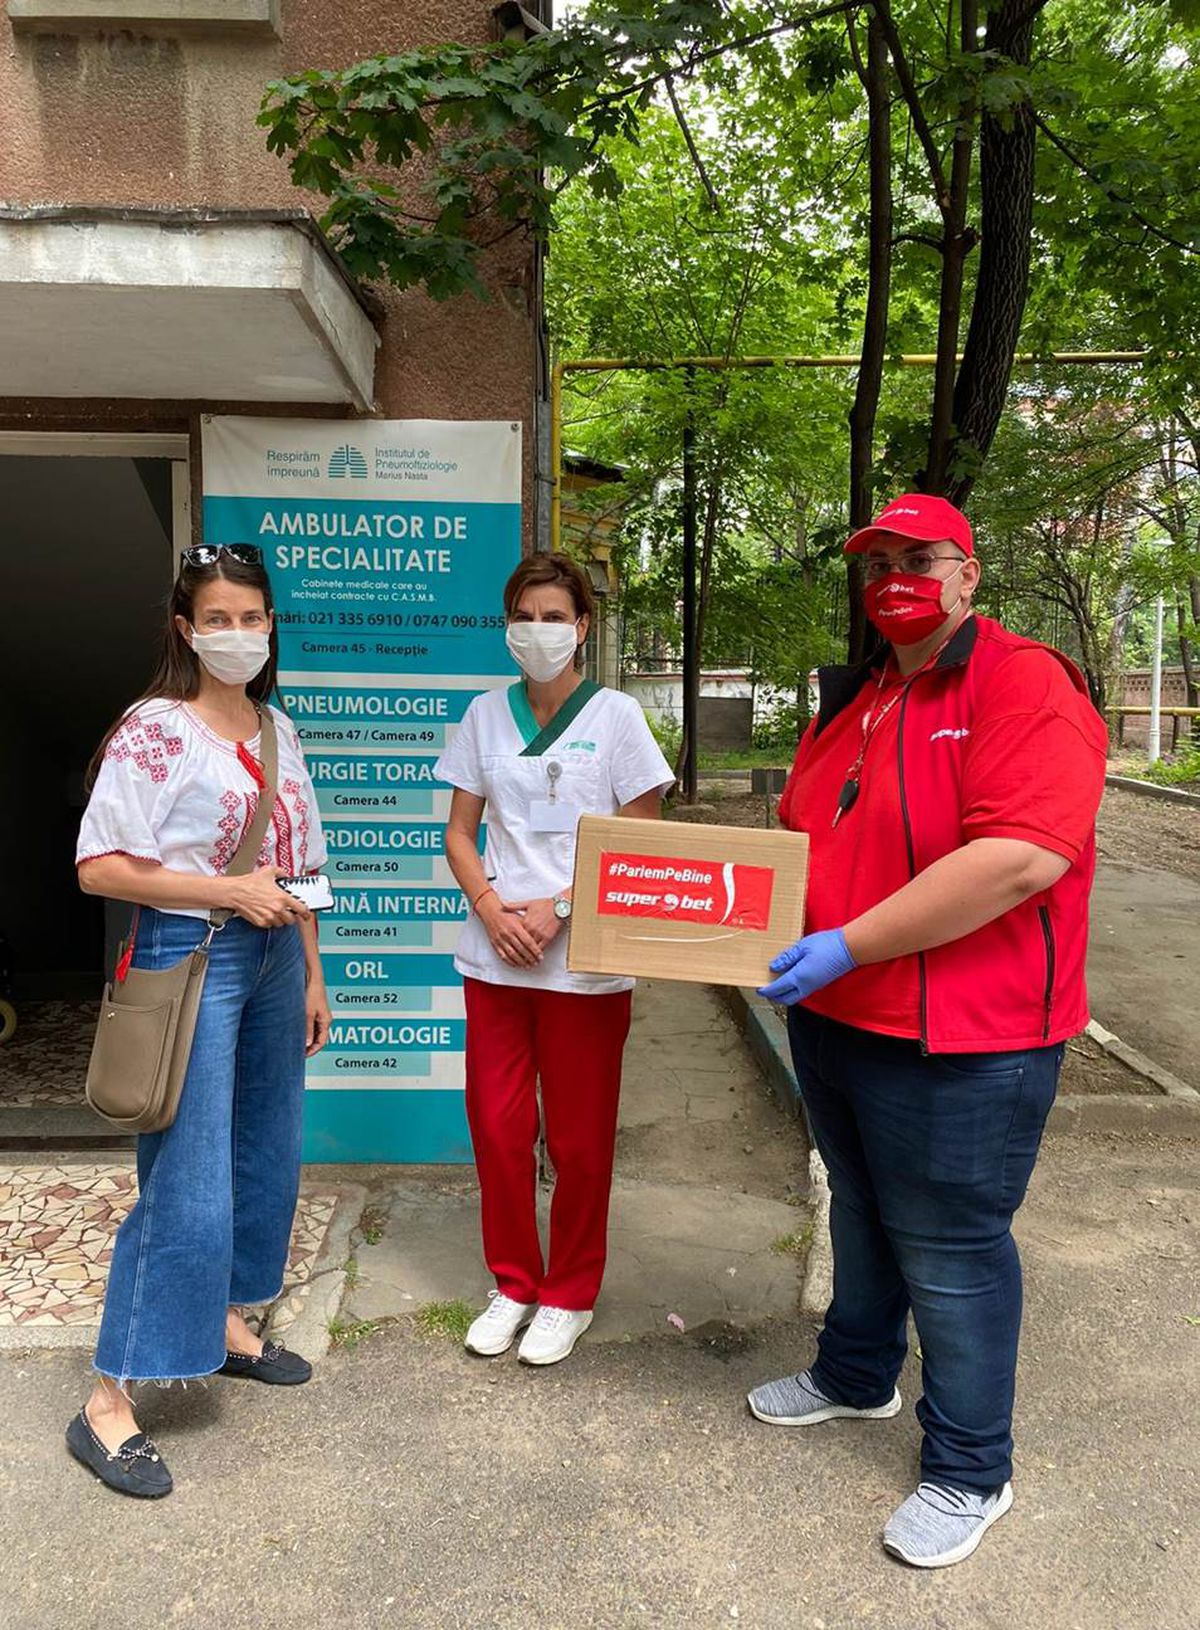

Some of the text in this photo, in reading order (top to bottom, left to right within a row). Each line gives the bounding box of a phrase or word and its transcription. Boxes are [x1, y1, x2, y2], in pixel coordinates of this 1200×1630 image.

[267, 449, 320, 463] Respirăm
[375, 447, 430, 459] Institutul de
[375, 471, 402, 480] Marius
[259, 511, 468, 540] AMBULATOR DE
[275, 545, 451, 573] SPECIALITATE
[301, 578, 427, 591] Cabinete medicale care au
[331, 591, 375, 601] contracte
[377, 593, 389, 602] cu
[308, 611, 334, 625] 021
[338, 612, 364, 626] 335
[367, 613, 403, 627] 6910
[413, 614, 448, 627] 0747
[451, 614, 478, 628] 090
[479, 615, 506, 629] 355
[301, 641, 348, 654] Camera
[351, 643, 366, 654] 45
[283, 694, 448, 717] PNEUMOLOGIE
[297, 728, 435, 742] Camera 47 / Camera 49
[309, 761, 368, 781] URGIE
[334, 794, 397, 806] Camera 44
[324, 829, 442, 849] RDIOLOGIE
[335, 861, 399, 873] Camera 50
[609, 862, 713, 885] #PariemPeBine
[335, 926, 397, 938] Camera 41
[345, 960, 389, 980] ORL
[335, 992, 398, 1004] Camera 52
[326, 1025, 451, 1045] MATOLOGIE
[335, 1057, 397, 1069] Camera 42
